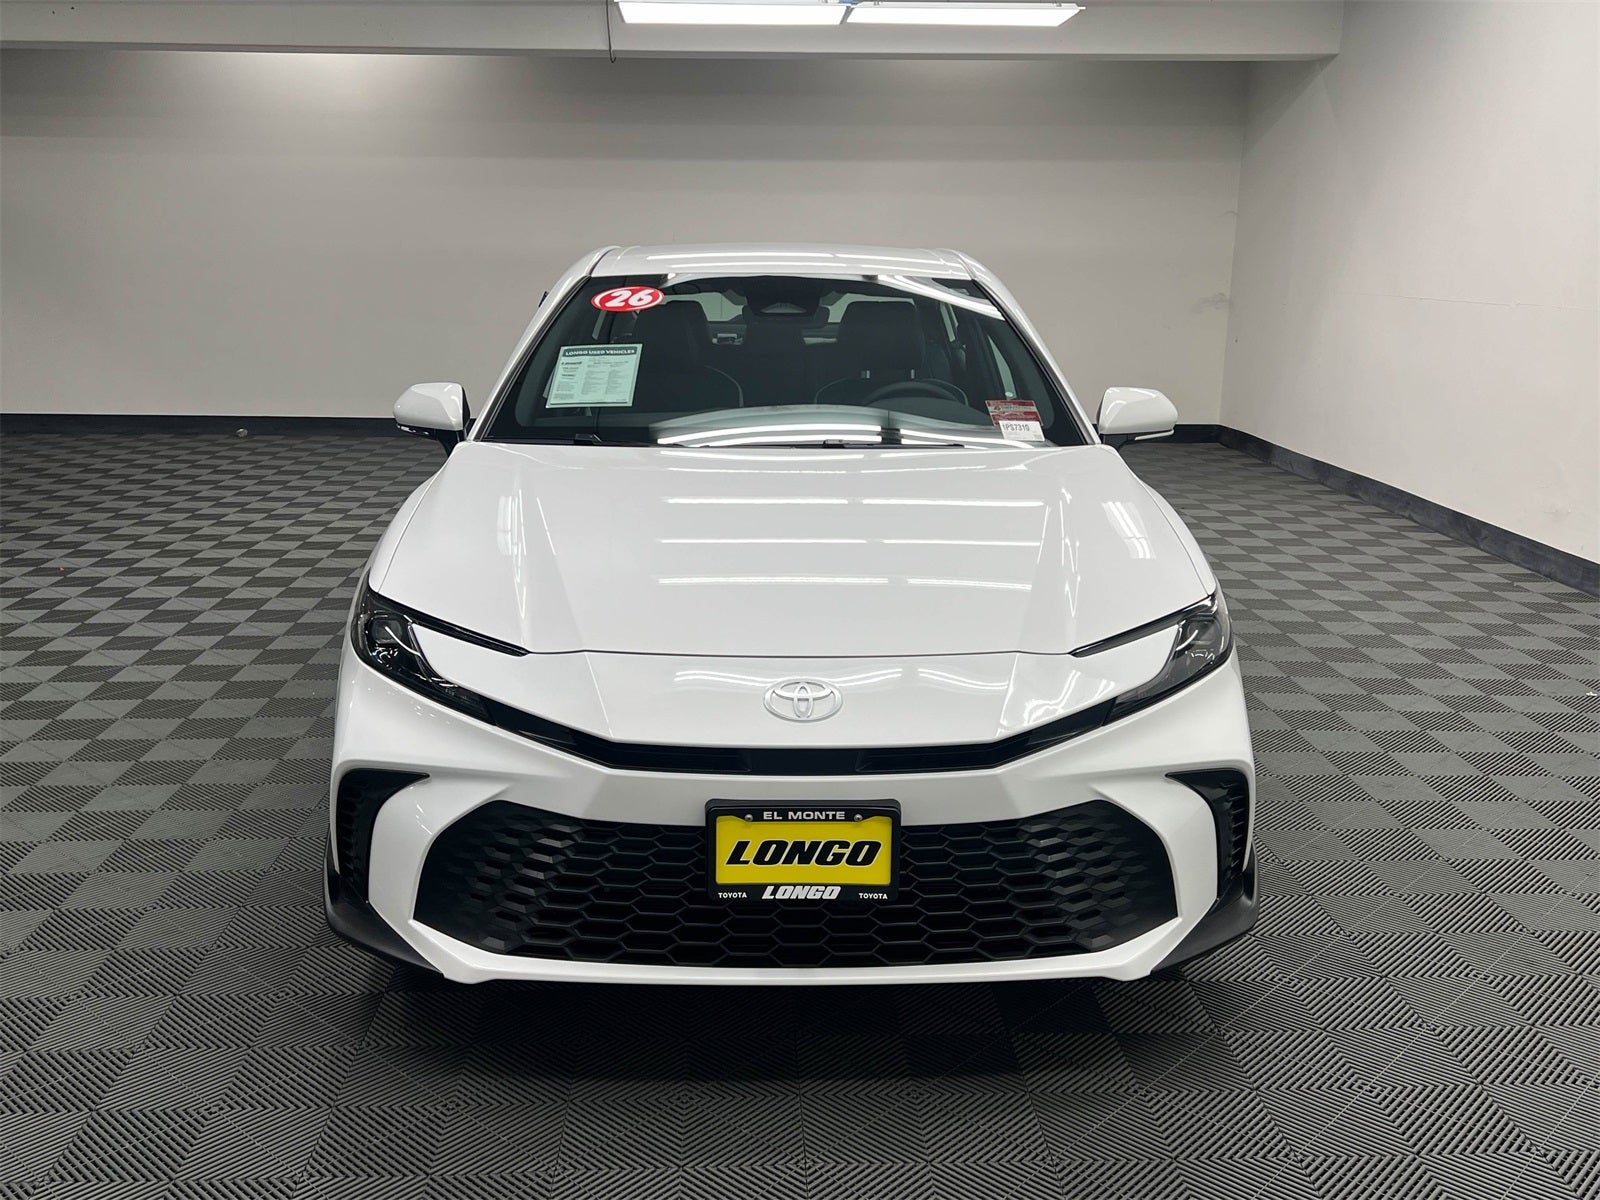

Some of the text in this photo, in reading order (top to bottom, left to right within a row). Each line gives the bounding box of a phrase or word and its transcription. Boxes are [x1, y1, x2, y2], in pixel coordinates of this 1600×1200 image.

[604, 289, 655, 307] 26
[763, 811, 846, 820] EL MONTE
[726, 840, 882, 867] LONGO
[761, 885, 842, 900] LONGO
[858, 892, 888, 900] TOYOTA
